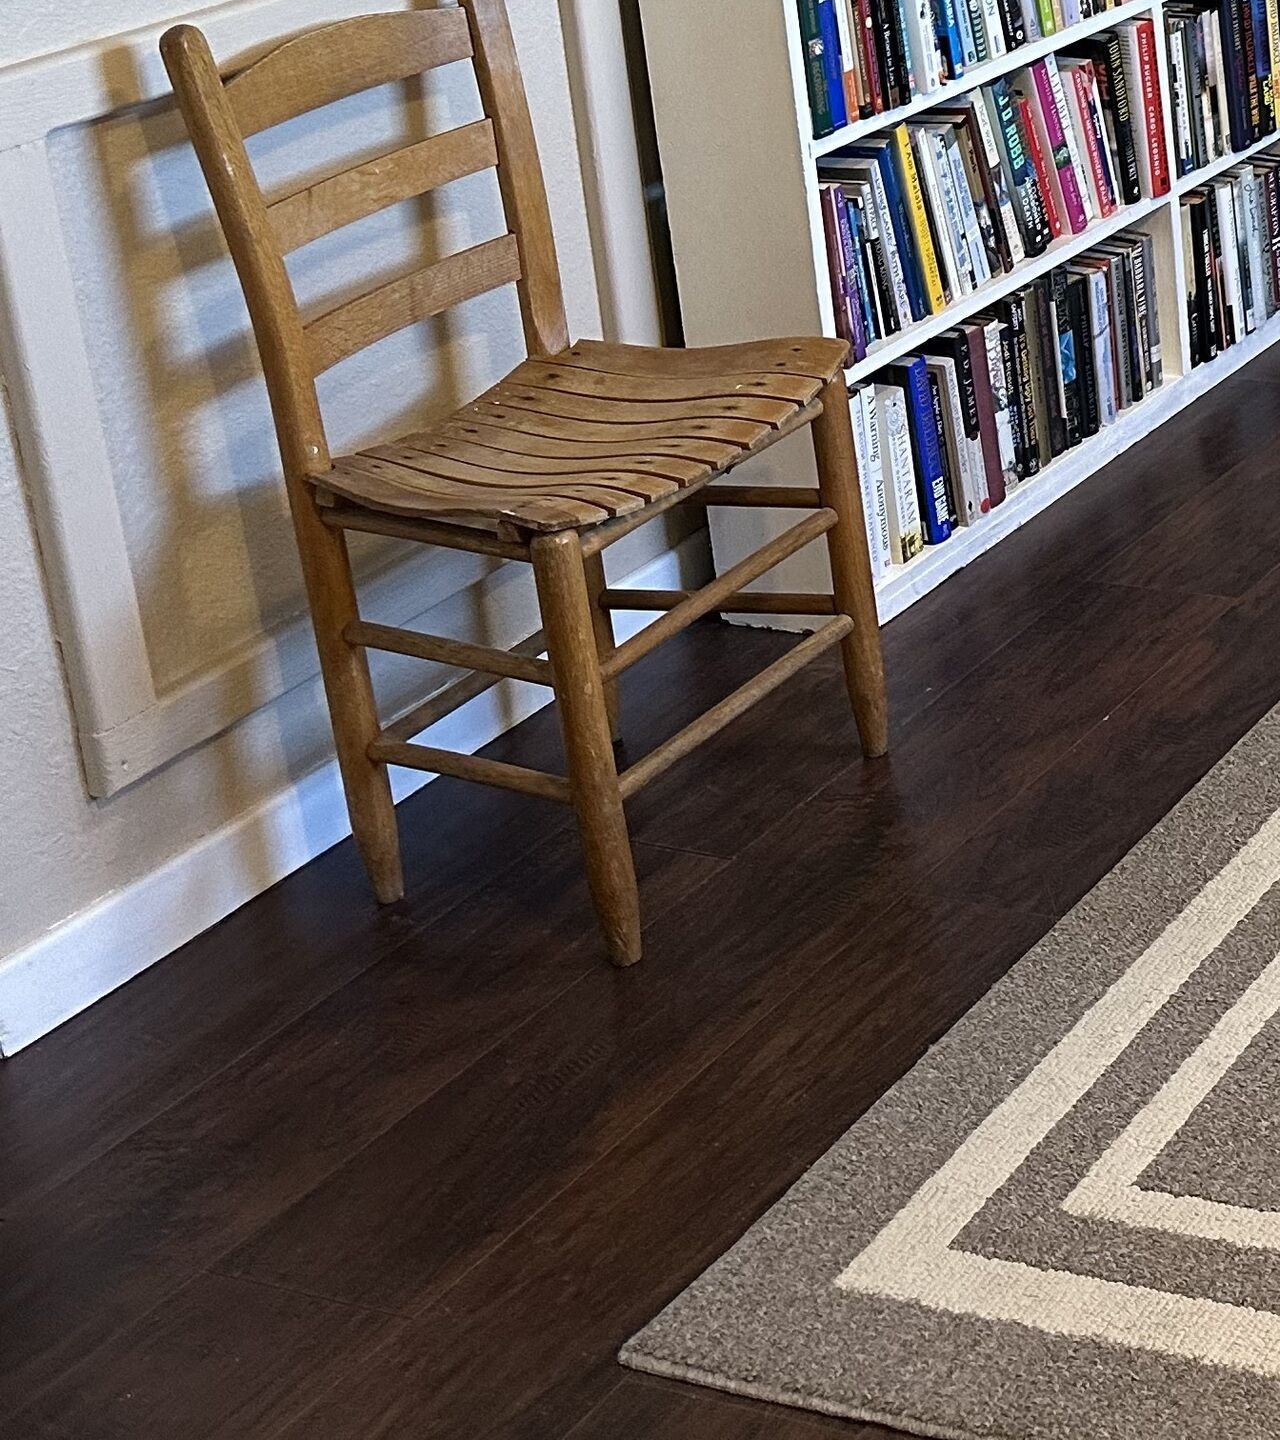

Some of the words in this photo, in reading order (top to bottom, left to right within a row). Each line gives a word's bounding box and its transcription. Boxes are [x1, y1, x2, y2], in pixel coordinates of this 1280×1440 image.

[1242, 3, 1251, 29] DAVID
[883, 30, 892, 57] Return
[1108, 40, 1121, 68] JOHN
[1141, 33, 1149, 61] PHILIP
[1244, 31, 1255, 73] BALDACCI
[1271, 22, 1280, 65] BALDACCI
[887, 58, 892, 66] to
[888, 66, 896, 86] Love
[1112, 68, 1129, 122] SANDFORD
[1144, 64, 1153, 98] RUCKER
[1249, 75, 1258, 94] WALK
[1262, 80, 1270, 105] LAND
[1250, 95, 1258, 107] THE
[1268, 90, 1276, 117] MAN'S
[1048, 104, 1064, 142] HANNAH
[1093, 113, 1102, 139] Sydney
[1148, 106, 1156, 134] CAROL
[1251, 107, 1260, 126] WIRE
[1005, 126, 1026, 170] ROBB
[1076, 73, 1087, 108] CRUISING
[1085, 120, 1096, 151] MEXICAN
[1092, 152, 1102, 178] RIVIERA
[1099, 187, 1107, 204] BAJA
[968, 149, 978, 174] Paris
[905, 150, 914, 170] Am
[910, 175, 923, 211] Malala
[880, 211, 892, 241] GAME
[1022, 198, 1034, 229] DEATH
[1269, 192, 1279, 235] GRAFTON
[875, 241, 885, 267] HONG
[890, 250, 902, 278] RUTH
[879, 267, 889, 289] KONG
[1133, 258, 1145, 294] BARBARA
[895, 278, 906, 307] WARE
[1136, 296, 1146, 317] VINE
[960, 345, 968, 356] P.
[1002, 340, 1011, 360] Jodi
[1019, 333, 1027, 349] It's
[946, 365, 957, 395] North
[962, 360, 971, 373] D.
[1004, 362, 1014, 395] Picoult
[1019, 350, 1030, 382] Getting
[1080, 315, 1089, 348] PHILIP
[1086, 364, 1096, 418] ELIZABETH
[868, 395, 875, 404] A
[914, 366, 931, 410] DAVID
[931, 385, 938, 395] An
[964, 378, 977, 425] JAMES
[1023, 382, 1032, 402] Ugly
[932, 396, 941, 414] Apple
[951, 395, 963, 433] Carolina
[1026, 404, 1034, 419] Out
[867, 406, 883, 462] Warning
[936, 420, 944, 434] Day
[1028, 421, 1037, 445] There
[858, 432, 867, 460] ROOM
[921, 411, 940, 478] BALDACCI
[957, 435, 969, 474] Traveler
[862, 464, 871, 498] WHERE
[894, 424, 918, 524] SHANTARAM
[932, 477, 945, 498] END
[874, 479, 891, 551] Anonymous
[898, 496, 907, 528] ROBERTS
[935, 497, 950, 526] GAME
[868, 514, 878, 562] HAPPENED
